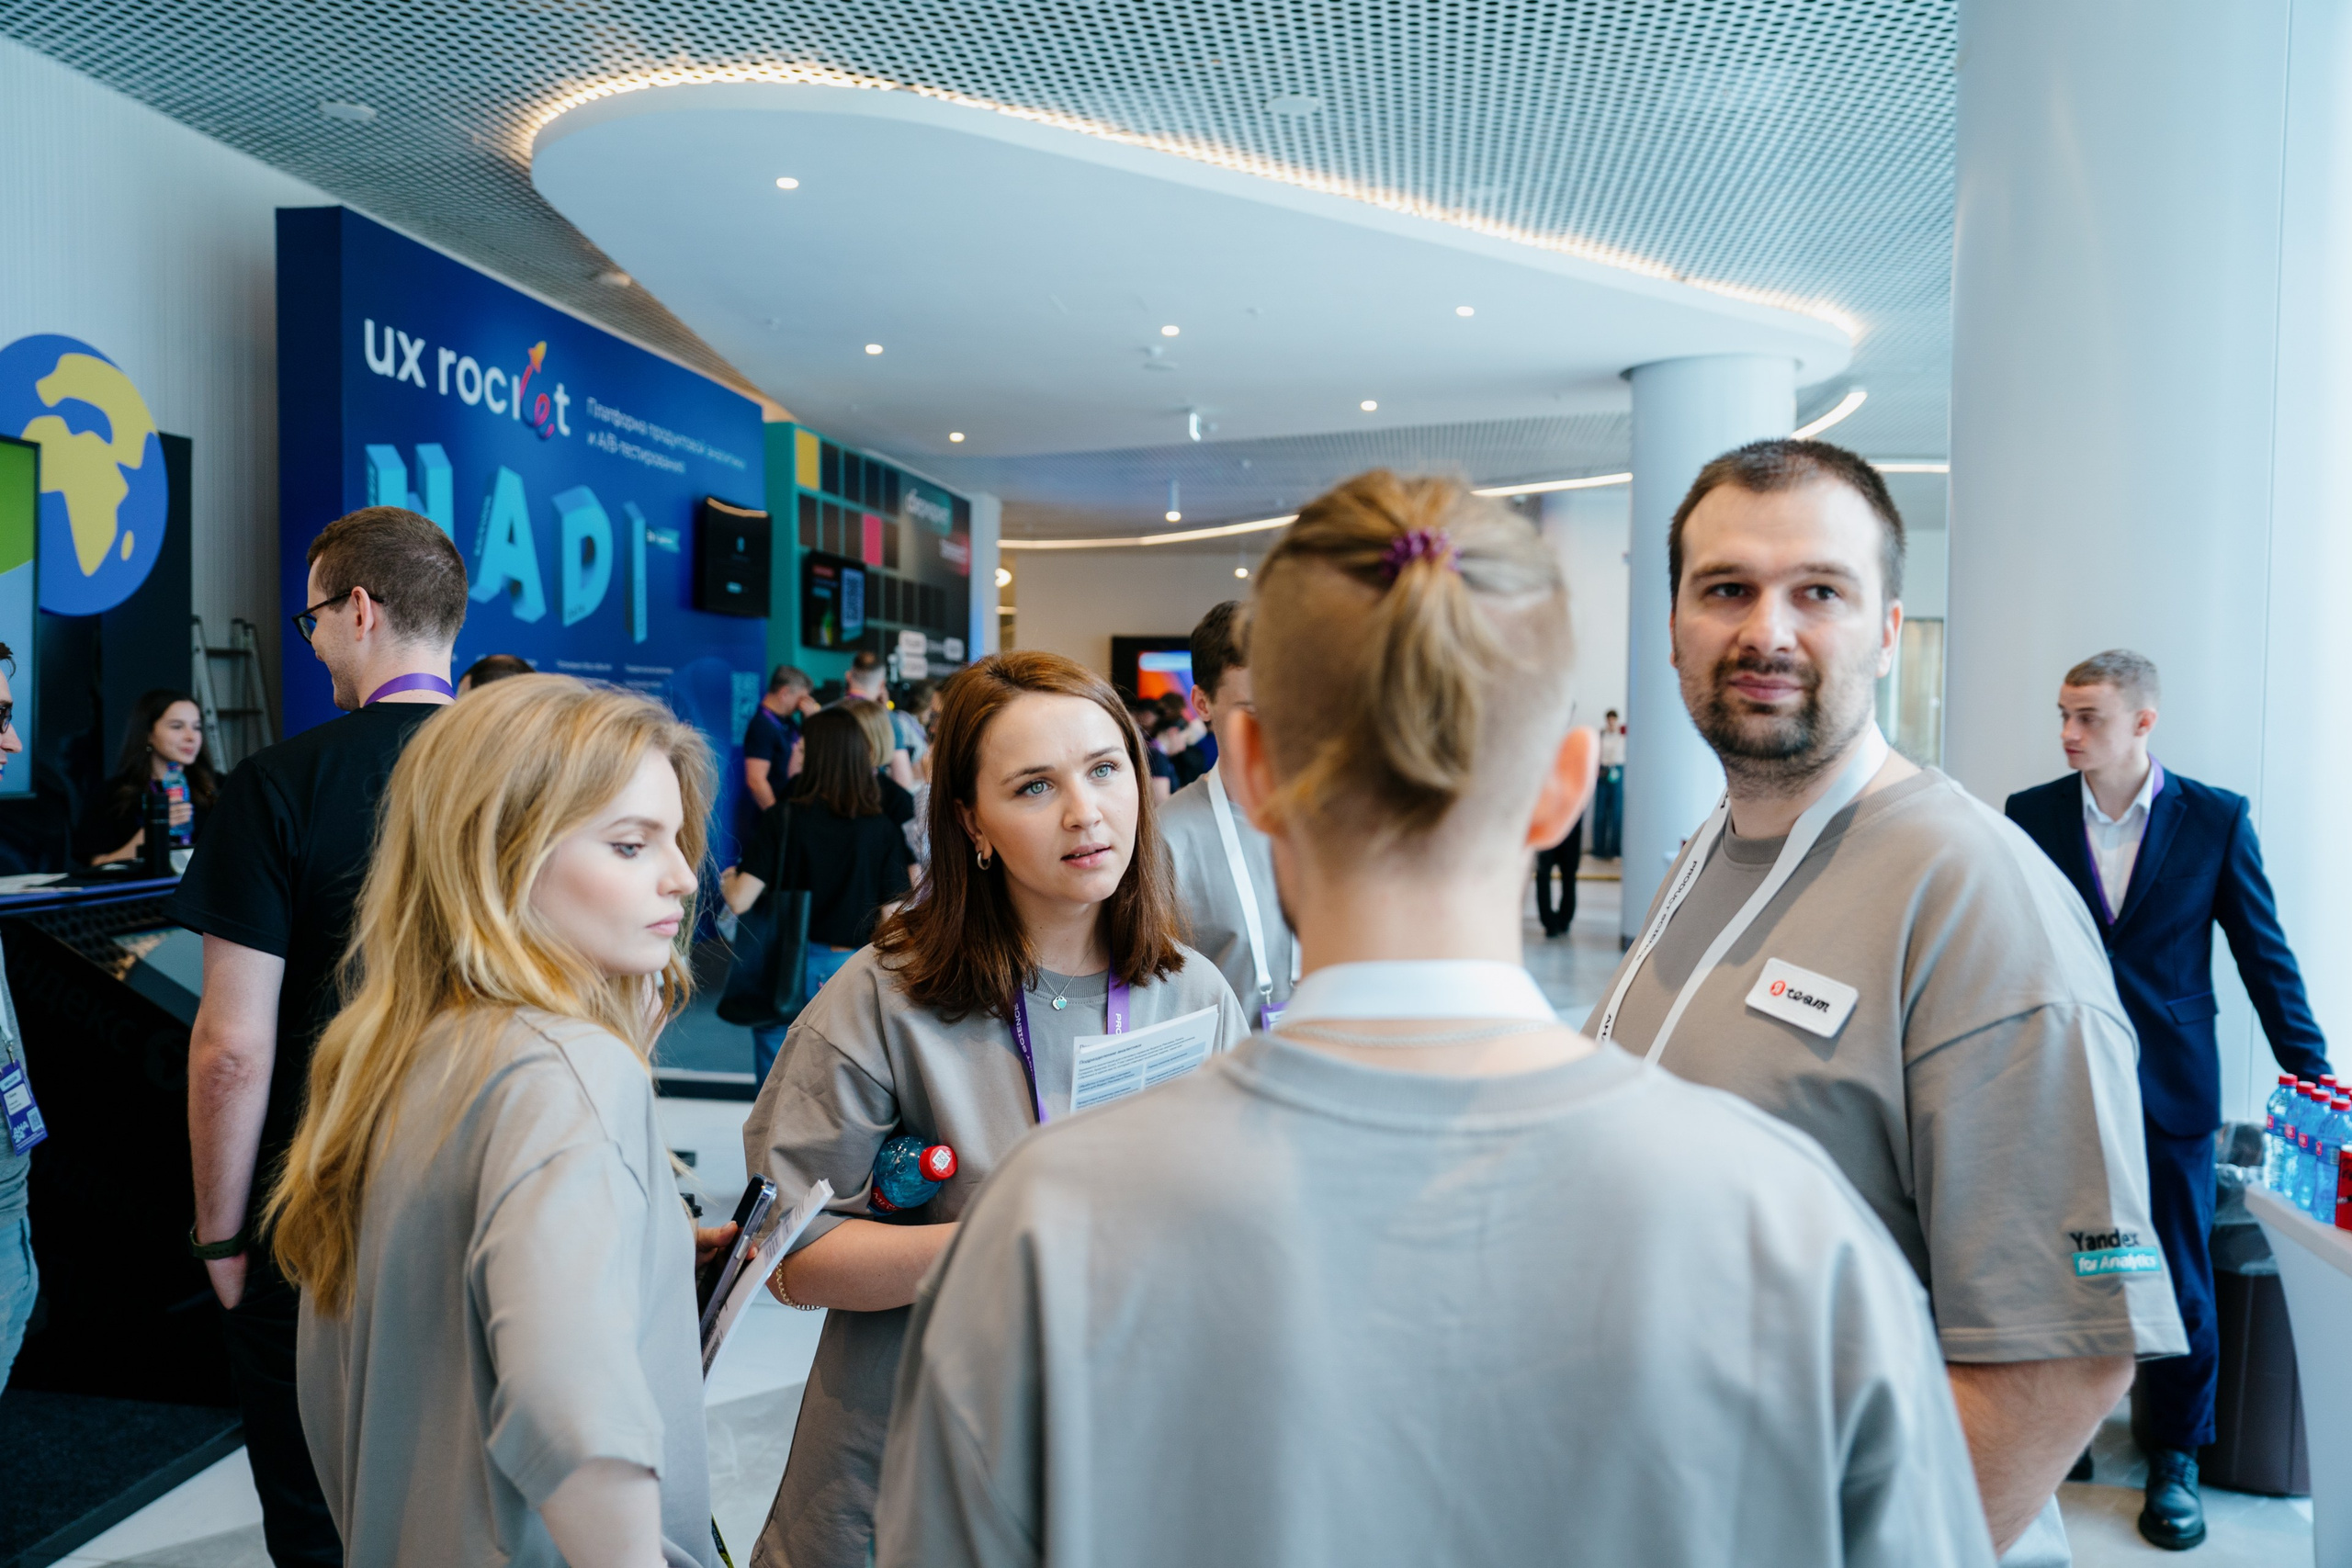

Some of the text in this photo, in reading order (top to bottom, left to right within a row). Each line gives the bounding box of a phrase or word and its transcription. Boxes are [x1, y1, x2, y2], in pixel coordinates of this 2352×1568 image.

[365, 319, 425, 389] ux
[1635, 860, 1698, 962] PRODUCT SCIENCE
[1787, 987, 1830, 1013] team
[1013, 1002, 1028, 1054] SCIENCE
[2069, 1228, 2140, 1251] Yandex
[2078, 1257, 2098, 1273] for
